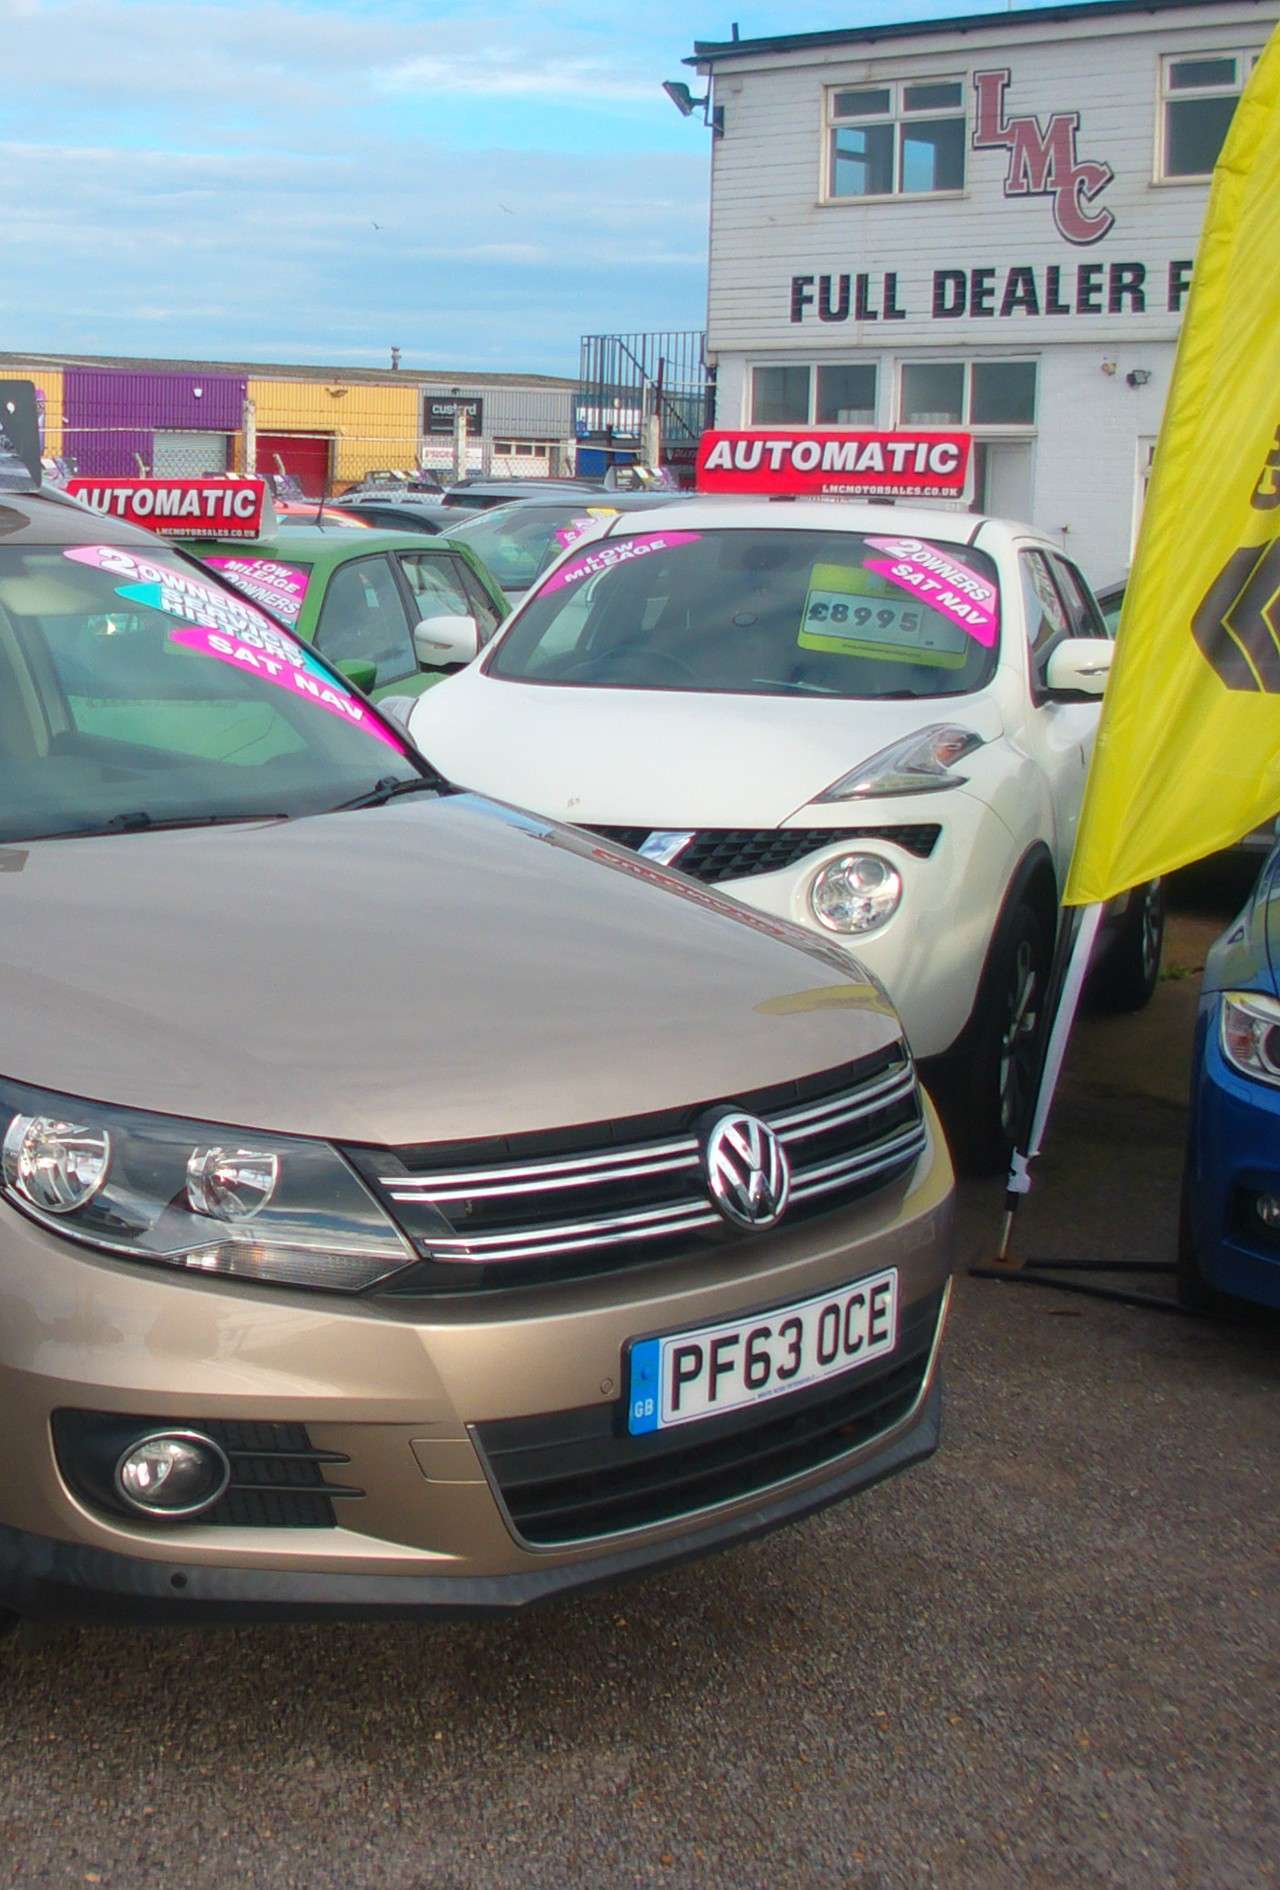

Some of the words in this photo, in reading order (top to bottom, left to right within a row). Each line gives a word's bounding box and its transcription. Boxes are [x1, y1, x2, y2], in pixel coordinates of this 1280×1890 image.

[972, 67, 1115, 245] LMC
[790, 273, 906, 324] FULL
[932, 261, 1147, 319] DEALER
[432, 403, 477, 415] custrd
[704, 440, 958, 475] AUTOMATIC
[74, 487, 257, 518] AUTOMATIC
[822, 484, 958, 497] LMCMOTORSALES.CO.UK
[252, 560, 293, 578] LOW
[564, 539, 666, 583] MILEAGE
[585, 541, 635, 565] LOW
[224, 560, 301, 593] MILEAGE
[891, 563, 941, 591] SAT
[936, 593, 989, 625] NAV
[161, 588, 304, 656] SERVICE
[161, 597, 306, 669] HISTORY
[807, 602, 919, 632] £8995
[208, 634, 283, 676] SAT
[294, 673, 363, 721] NAV
[671, 1316, 803, 1411] PF63
[816, 1281, 891, 1366] OCE
[634, 1400, 654, 1418] GB
